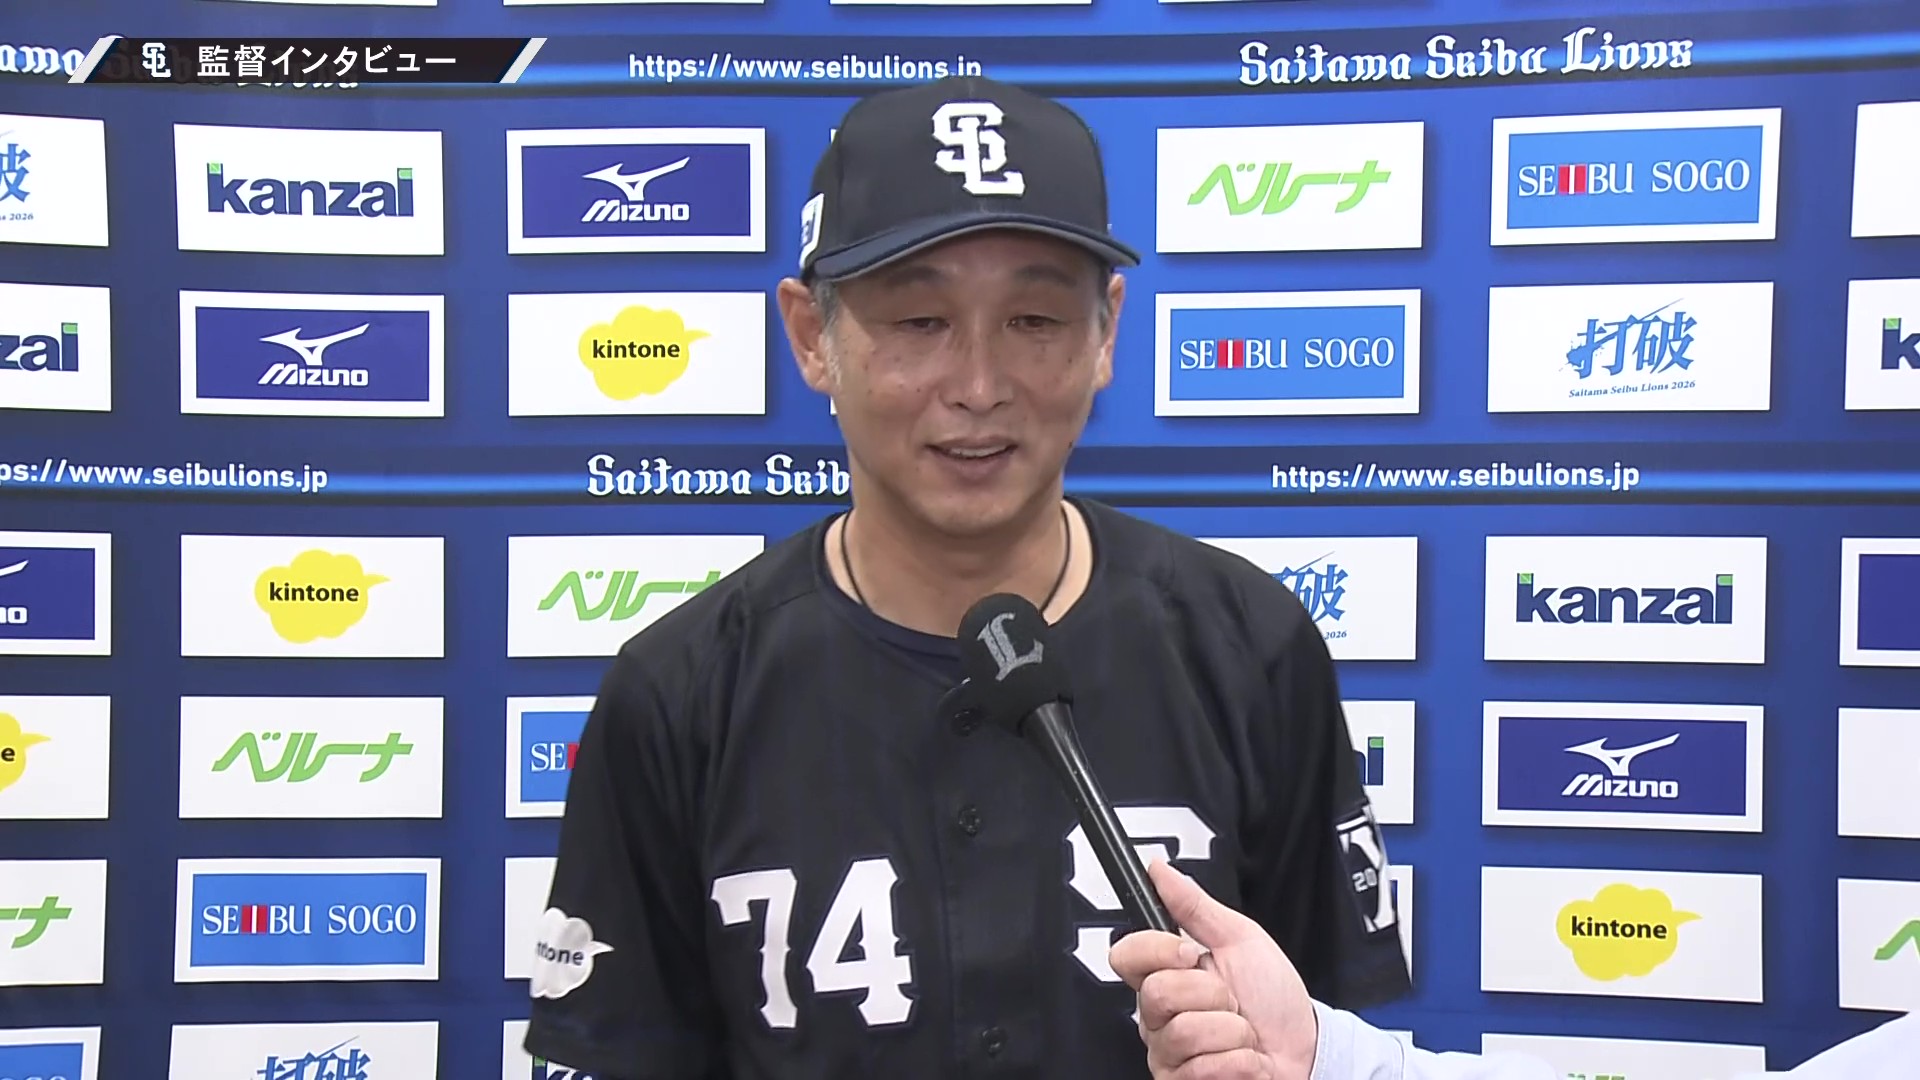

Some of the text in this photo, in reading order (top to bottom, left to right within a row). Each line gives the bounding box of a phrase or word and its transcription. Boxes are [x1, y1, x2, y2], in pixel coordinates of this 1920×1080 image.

[1239, 26, 1694, 85] Saitama Seibu Lions
[207, 162, 415, 218] kanzai
[1187, 159, 1392, 216] ベルーナ
[1518, 158, 1751, 198] SEIBU SOGO
[581, 199, 690, 222] MIZUNO
[592, 338, 681, 359] kintone
[1180, 337, 1395, 370] SEIBU SOGO
[1566, 311, 1698, 380] 打破
[257, 362, 369, 387] MIZUNO
[1568, 379, 1696, 398] Saitama Seibu Lions 2026
[587, 454, 752, 496] Saitama
[1272, 461, 1641, 493] https://www.seibulions.jp
[268, 581, 360, 603] kintone
[1515, 572, 1735, 625] kanzai
[211, 731, 414, 784] ベルーナ
[1561, 774, 1680, 799] MIZUNO
[202, 904, 417, 935] SEIBU SOGO
[1570, 914, 1668, 940] kintone
[711, 857, 915, 1029] 74
